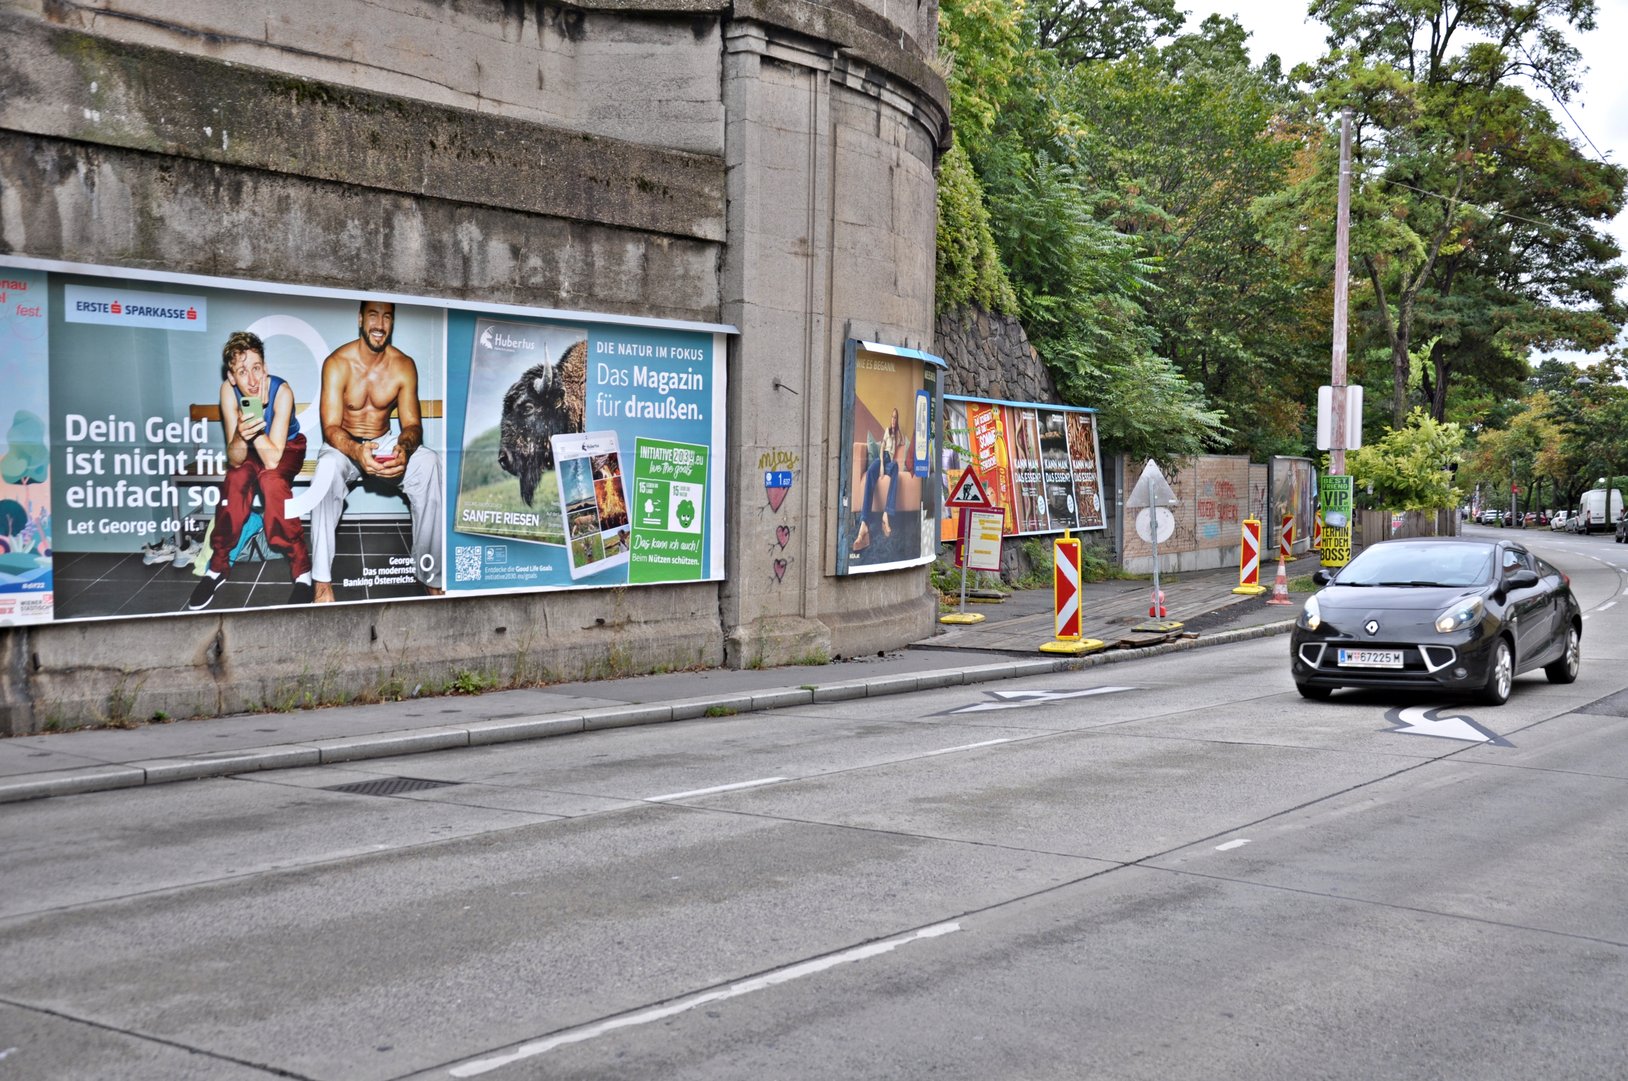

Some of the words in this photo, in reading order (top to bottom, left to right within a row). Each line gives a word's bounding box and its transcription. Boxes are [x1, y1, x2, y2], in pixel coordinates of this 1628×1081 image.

[16, 304, 42, 317] fest.
[76, 301, 109, 313] ERSTE
[125, 305, 185, 319] SPARKASSE
[495, 334, 535, 350] Hubertus
[597, 342, 614, 354] DIE
[618, 344, 653, 357] NATUR
[656, 346, 668, 358] IM
[670, 348, 704, 360] FOKUS
[598, 362, 629, 386] Das
[634, 366, 702, 394] Magazin
[596, 392, 621, 416] für
[625, 394, 702, 420] draußen.
[66, 414, 136, 442] Dein
[146, 416, 208, 443] Geld
[66, 447, 105, 475] ist
[114, 448, 188, 475] nicht
[195, 449, 226, 475] fit
[1014, 460, 1027, 469] KANN
[1028, 460, 1039, 469] MAN
[1044, 460, 1057, 469] KANN
[1058, 460, 1068, 469] MAN
[66, 480, 178, 508] einfach
[188, 484, 228, 507] so.
[1324, 491, 1348, 506] VIP
[463, 509, 502, 524] SANFTE
[503, 512, 539, 526] RIESEN
[67, 519, 94, 534] Let
[98, 518, 157, 536] George
[161, 517, 180, 532] do
[184, 516, 200, 532] it.
[1322, 526, 1349, 537] TERMIN
[1322, 538, 1332, 547] MIT
[1335, 538, 1348, 547] DEM
[389, 557, 416, 565] George.
[632, 553, 647, 562] Beim
[648, 554, 671, 564] Nützen
[672, 556, 700, 566] schützen.
[1320, 548, 1350, 560] BOSS?
[363, 568, 377, 576] Das
[378, 566, 416, 574] modernste
[343, 578, 373, 587] Banking
[1360, 652, 1391, 662] 67225
